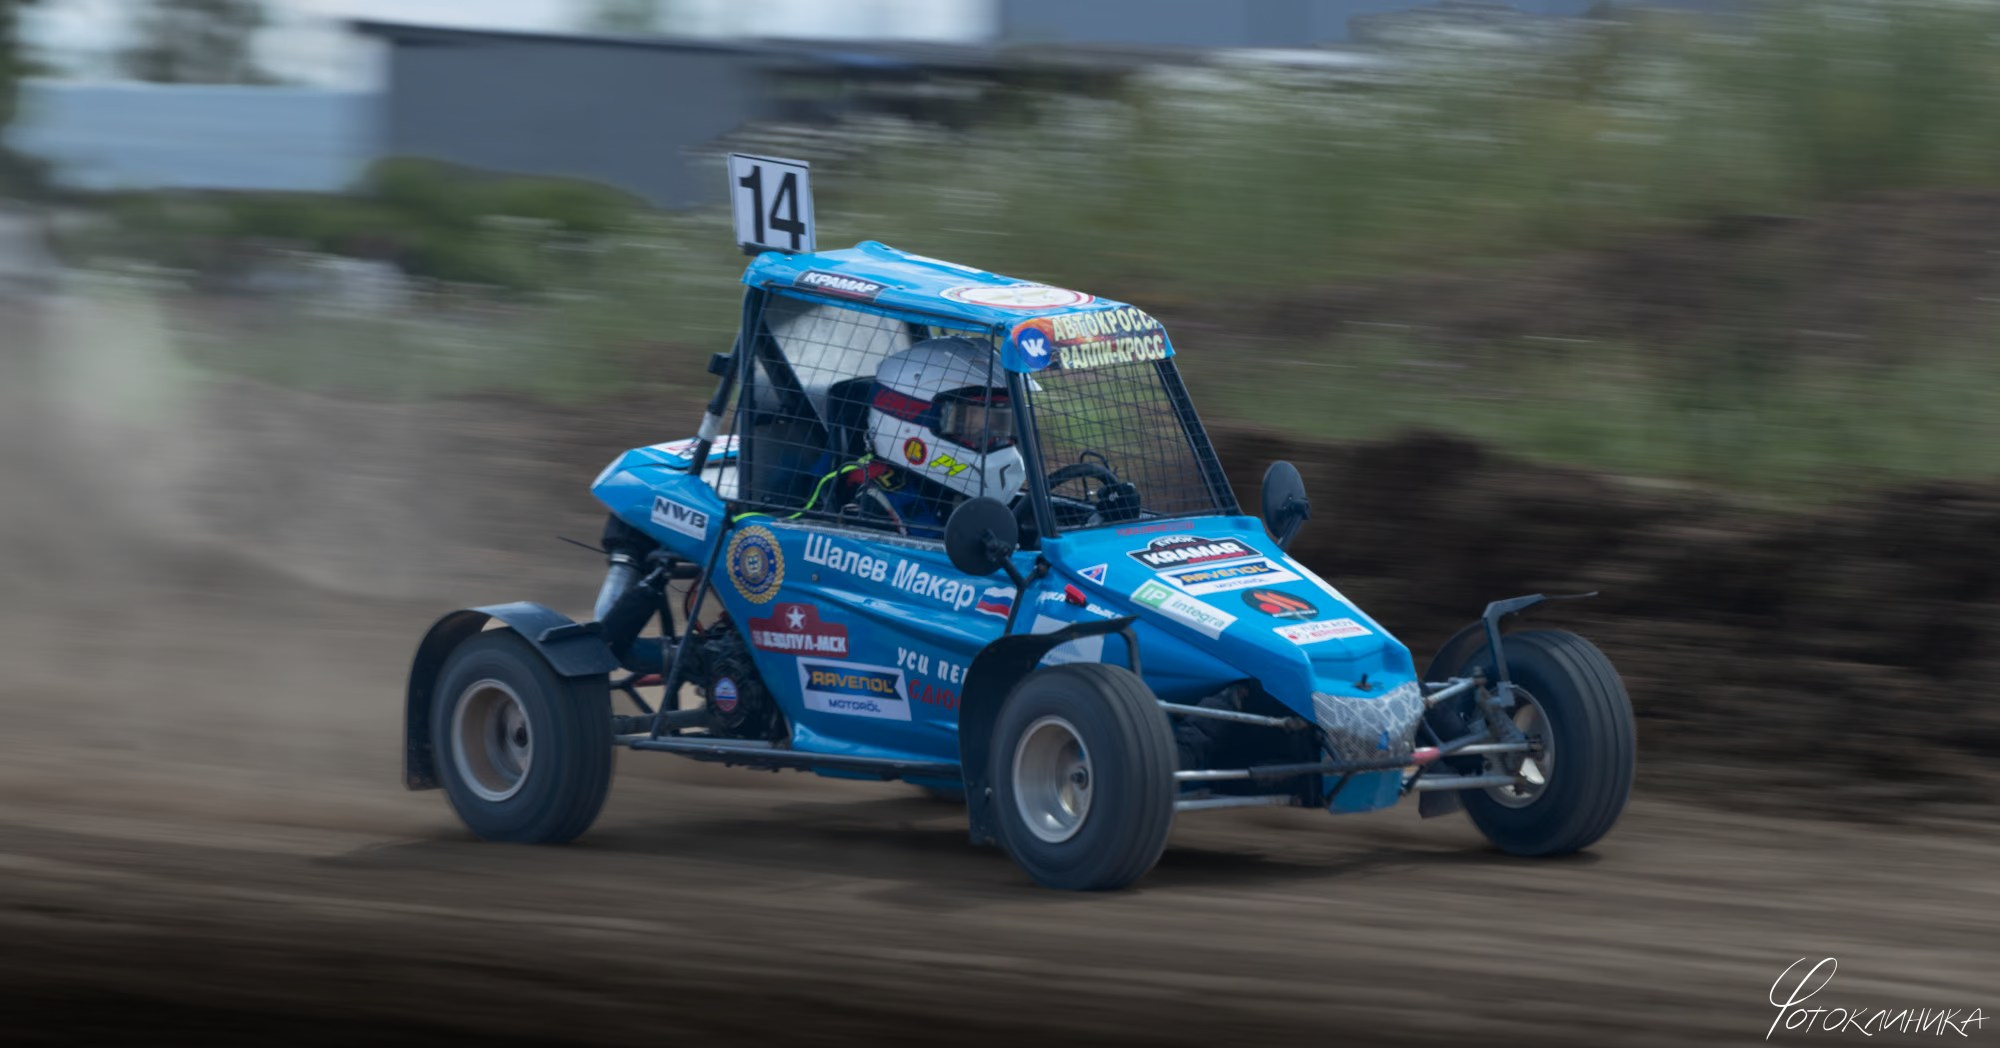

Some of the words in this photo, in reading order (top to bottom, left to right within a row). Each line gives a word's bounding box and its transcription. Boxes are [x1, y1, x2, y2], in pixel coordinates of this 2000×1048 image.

[739, 165, 806, 250] 14
[803, 272, 880, 293] КРАМАР
[654, 499, 707, 529] NWB
[1143, 541, 1243, 565] KRAMAR
[803, 533, 889, 582] Шалев
[891, 559, 976, 611] Макар
[1180, 564, 1271, 583] RAVENOL
[1171, 599, 1226, 627] integra
[811, 671, 894, 694] RAVENOL
[829, 699, 881, 713] MOTORÖL
